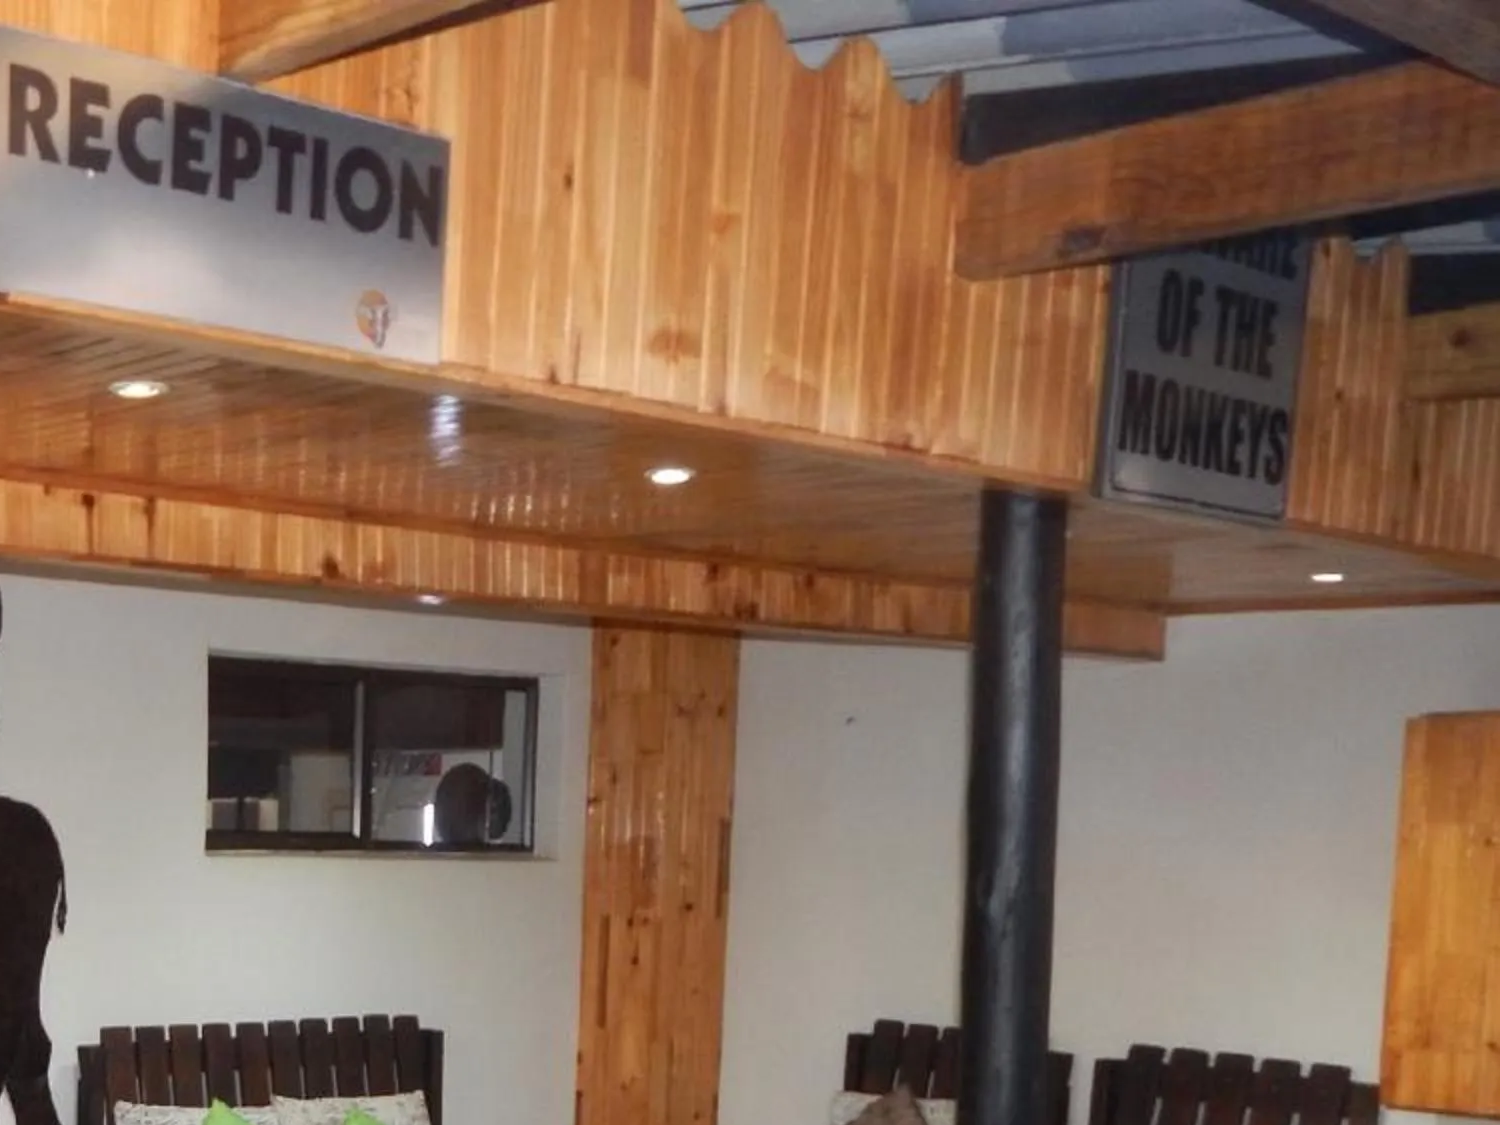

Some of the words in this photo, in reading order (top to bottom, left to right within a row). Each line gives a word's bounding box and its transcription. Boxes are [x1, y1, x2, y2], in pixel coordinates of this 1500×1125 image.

[8, 62, 443, 247] RECEPTION
[1156, 268, 1206, 357] OF
[1213, 285, 1279, 380] THE
[1118, 369, 1289, 485] MONKEYS
